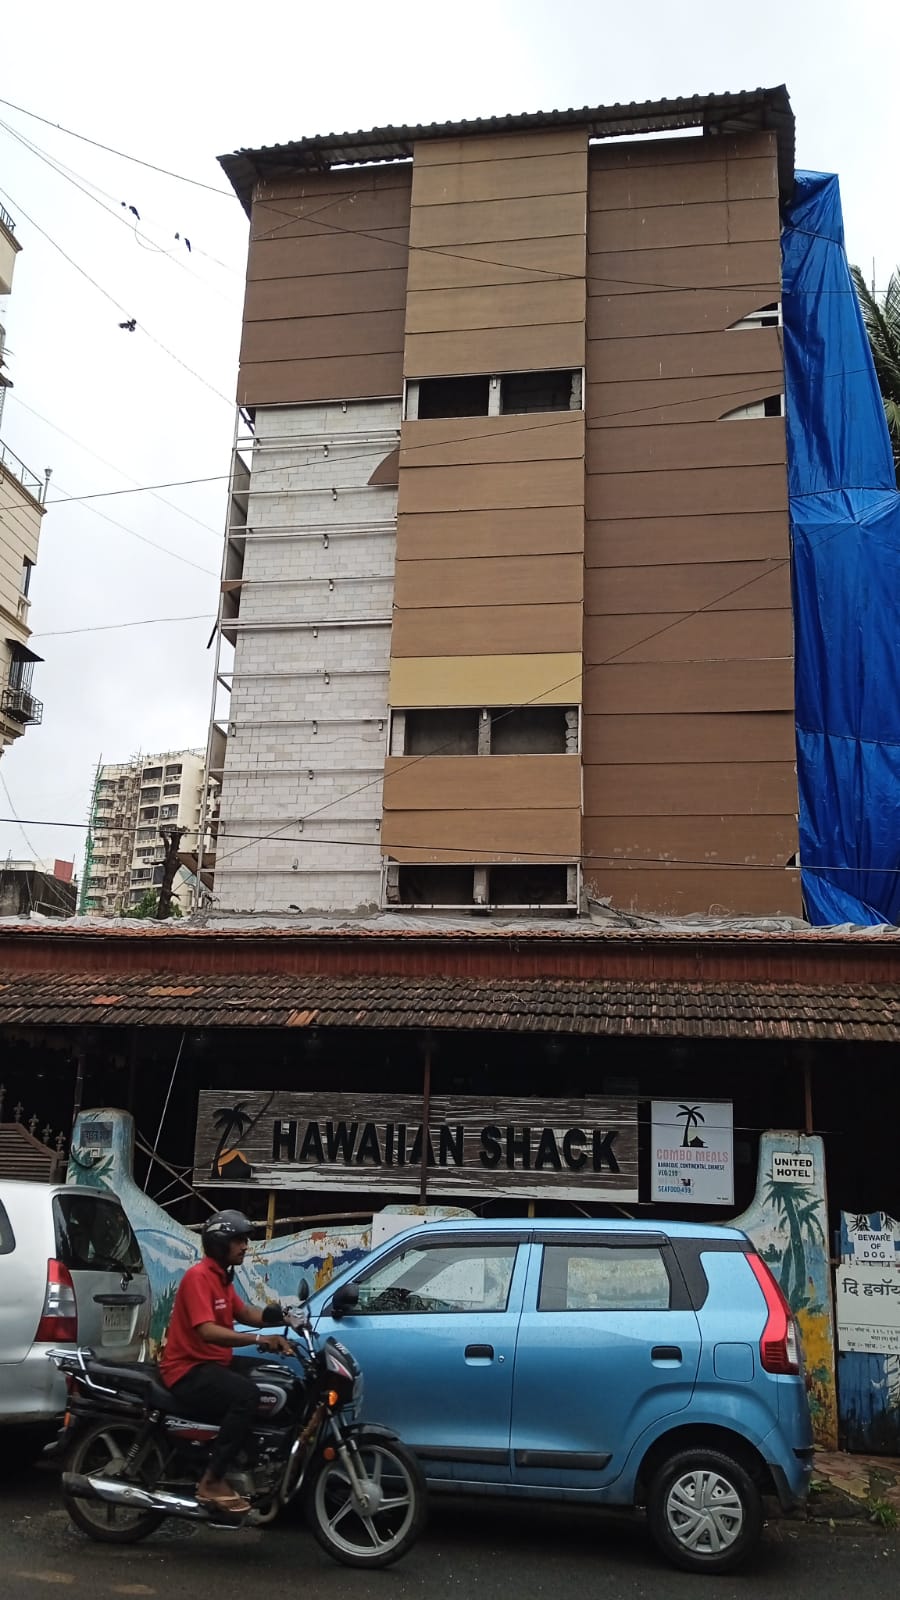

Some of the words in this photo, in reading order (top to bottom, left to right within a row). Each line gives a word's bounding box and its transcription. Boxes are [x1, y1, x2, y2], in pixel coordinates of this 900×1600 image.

[272, 1120, 464, 1167] HAWAIIAN
[479, 1124, 620, 1173] SHACK
[656, 1149, 692, 1161] COMBO
[695, 1151, 729, 1163] MEALS
[774, 1158, 813, 1167] UNITED
[777, 1168, 811, 1177] HOTEL
[842, 1277, 860, 1296] दि
